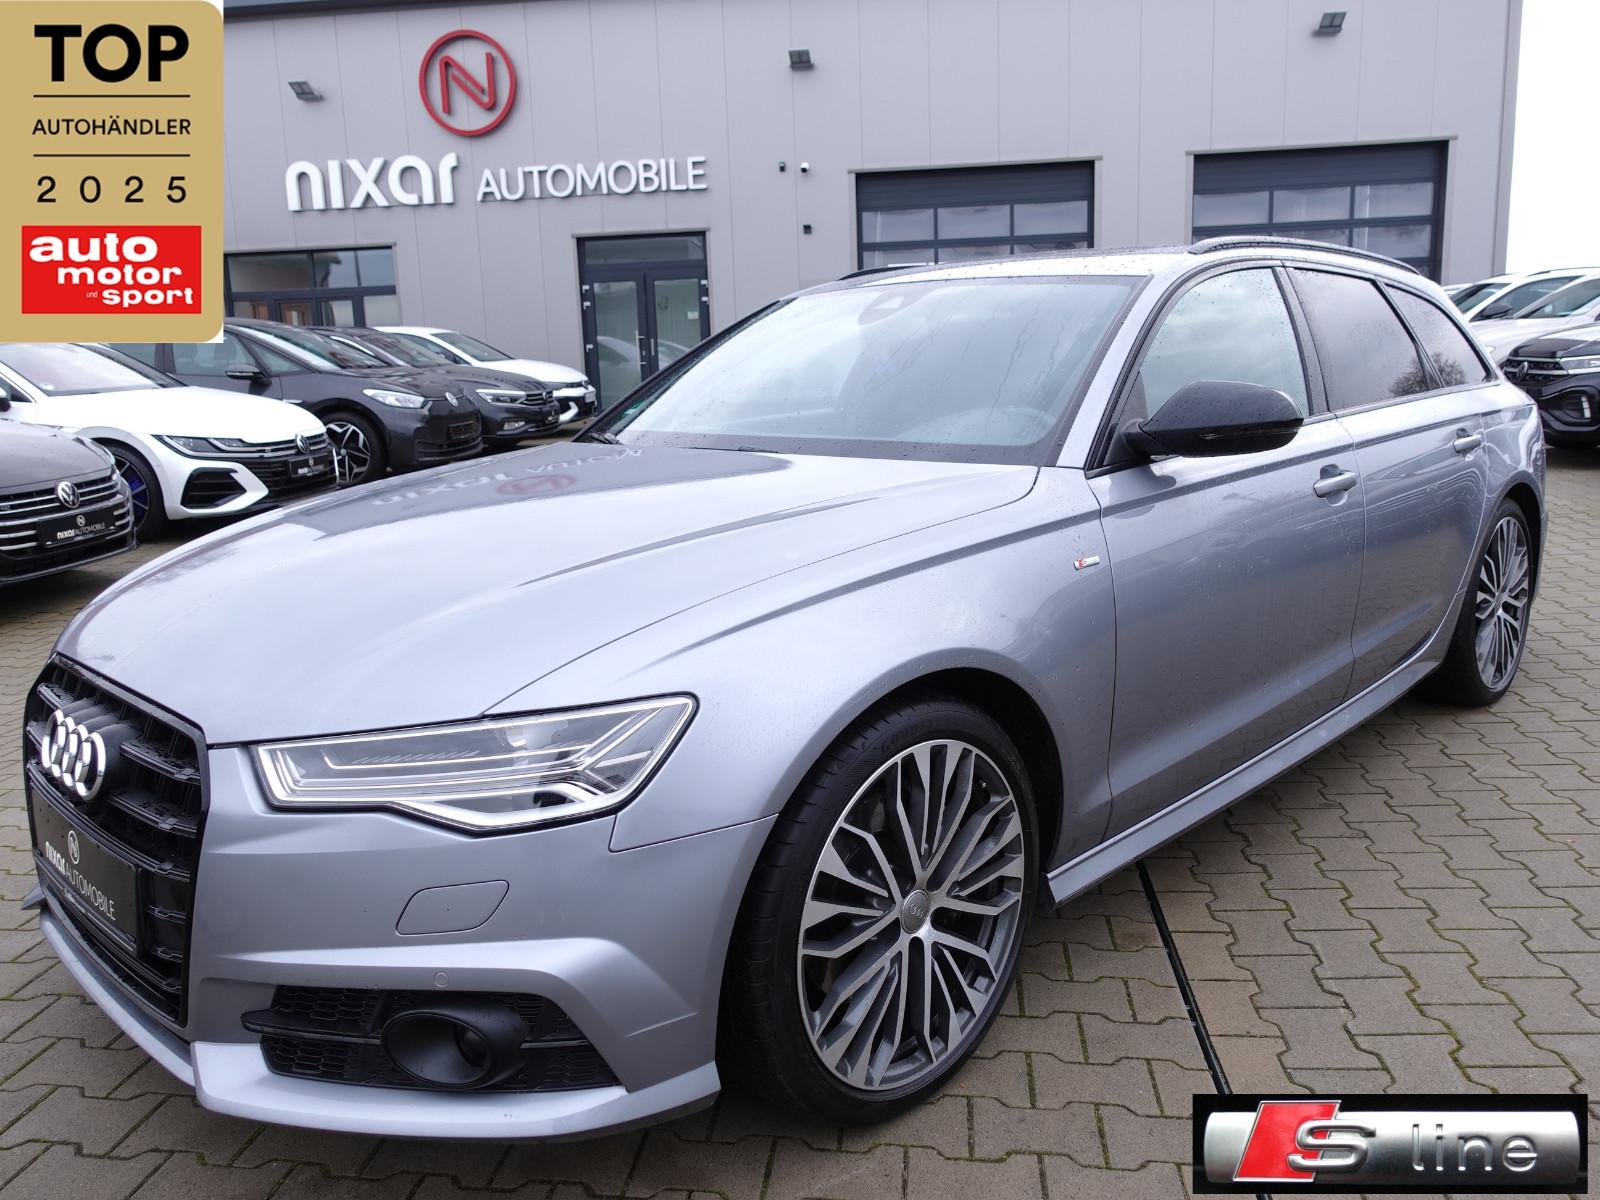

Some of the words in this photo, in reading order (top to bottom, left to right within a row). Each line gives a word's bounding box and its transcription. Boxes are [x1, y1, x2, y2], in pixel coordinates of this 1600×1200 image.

[285, 152, 458, 212] nixar
[476, 156, 708, 203] AUTOMOBILE
[65, 862, 116, 921] AUTOMOBILE
